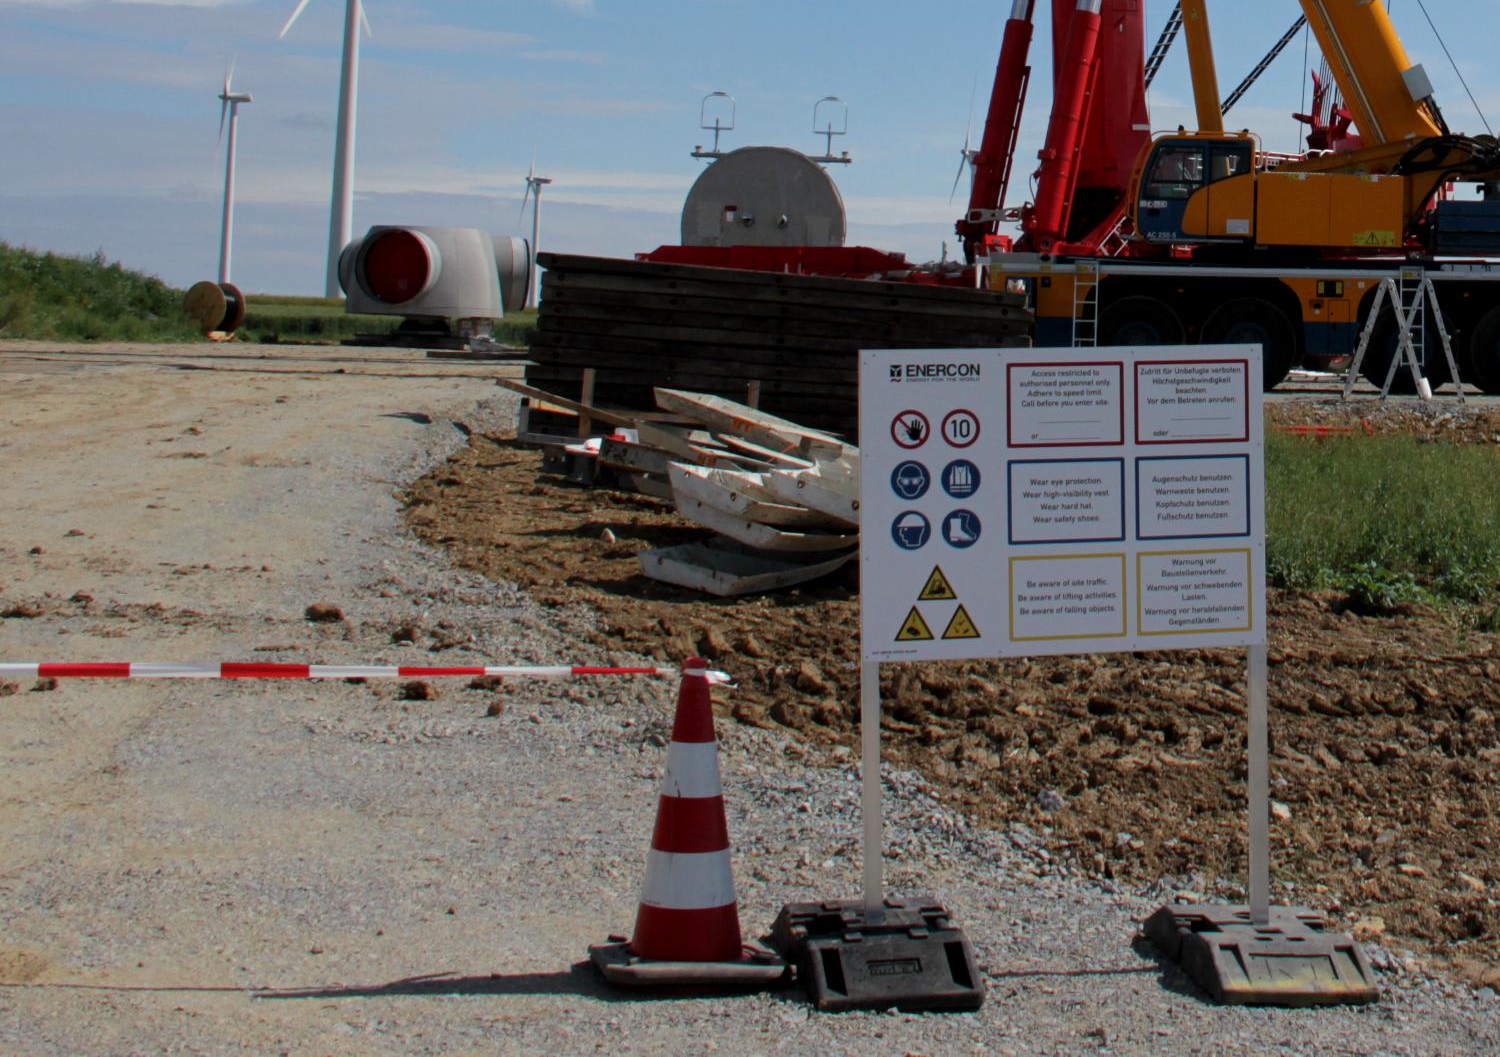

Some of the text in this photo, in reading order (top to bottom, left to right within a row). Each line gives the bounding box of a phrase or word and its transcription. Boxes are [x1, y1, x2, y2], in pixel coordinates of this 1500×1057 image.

[906, 364, 980, 376] ENERCON
[1058, 369, 1091, 377] restricted
[1174, 366, 1209, 375] Unbefugte
[1059, 379, 1094, 388] personnel
[1063, 390, 1084, 398] speed
[1177, 396, 1206, 404] Betreten
[951, 419, 970, 438] 10
[1030, 478, 1048, 486] Wear
[1152, 474, 1197, 484] Augenschutz
[1022, 491, 1042, 499] Wear
[1044, 490, 1092, 499] high-visibility
[1156, 500, 1194, 509] Kopfschutz
[1054, 515, 1076, 523] safety
[1172, 558, 1203, 566] Warnung
[1062, 579, 1070, 587] of
[1193, 580, 1242, 589] schwebenden
[1018, 594, 1027, 602] Be
[1062, 592, 1083, 601] lifting
[1020, 607, 1029, 615] Be
[1056, 606, 1063, 614] of
[1065, 606, 1087, 614] falling
[1145, 607, 1176, 615] Warnung
[1192, 605, 1244, 613] herabfallenden
